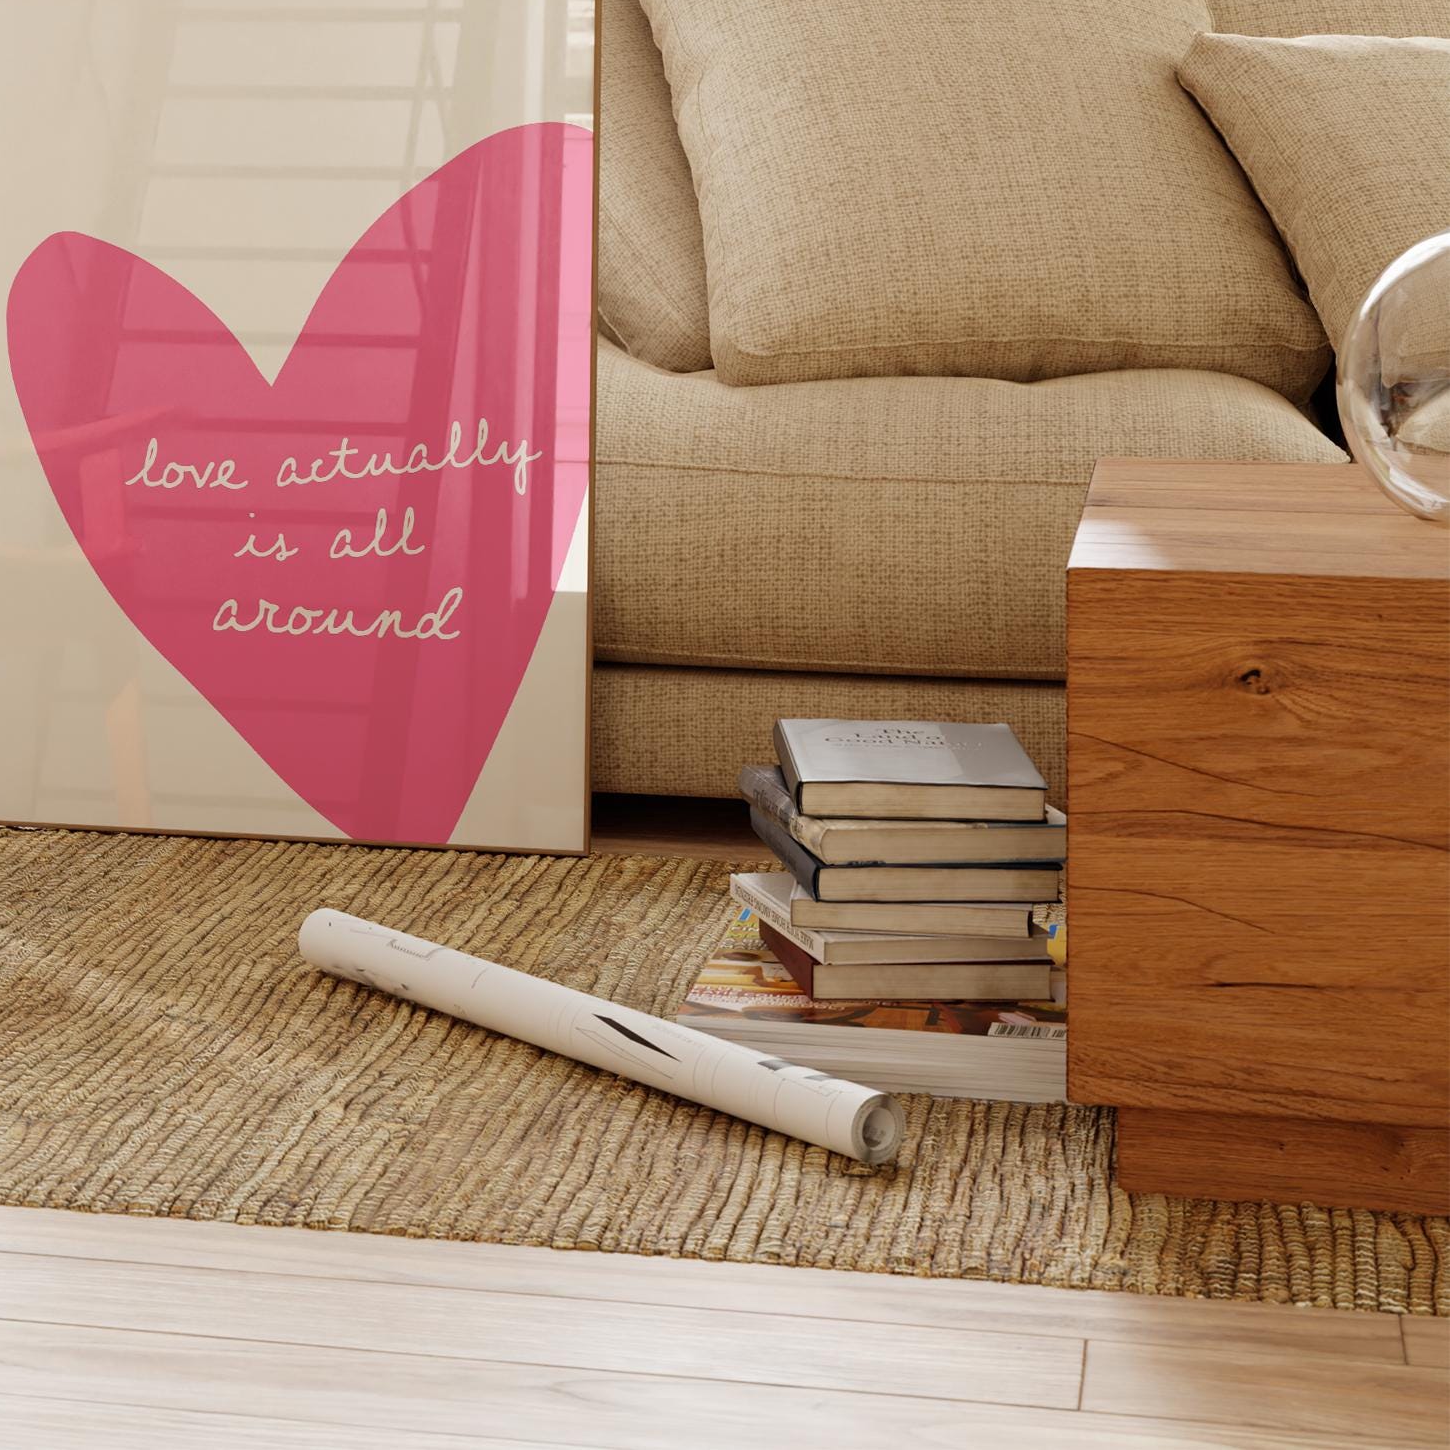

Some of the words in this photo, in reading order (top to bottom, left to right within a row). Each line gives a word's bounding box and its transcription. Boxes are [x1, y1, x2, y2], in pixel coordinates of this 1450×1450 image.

[125, 438, 248, 489] love
[277, 418, 542, 495] actually
[234, 512, 298, 561] is
[330, 507, 425, 558] all
[213, 587, 463, 640] around
